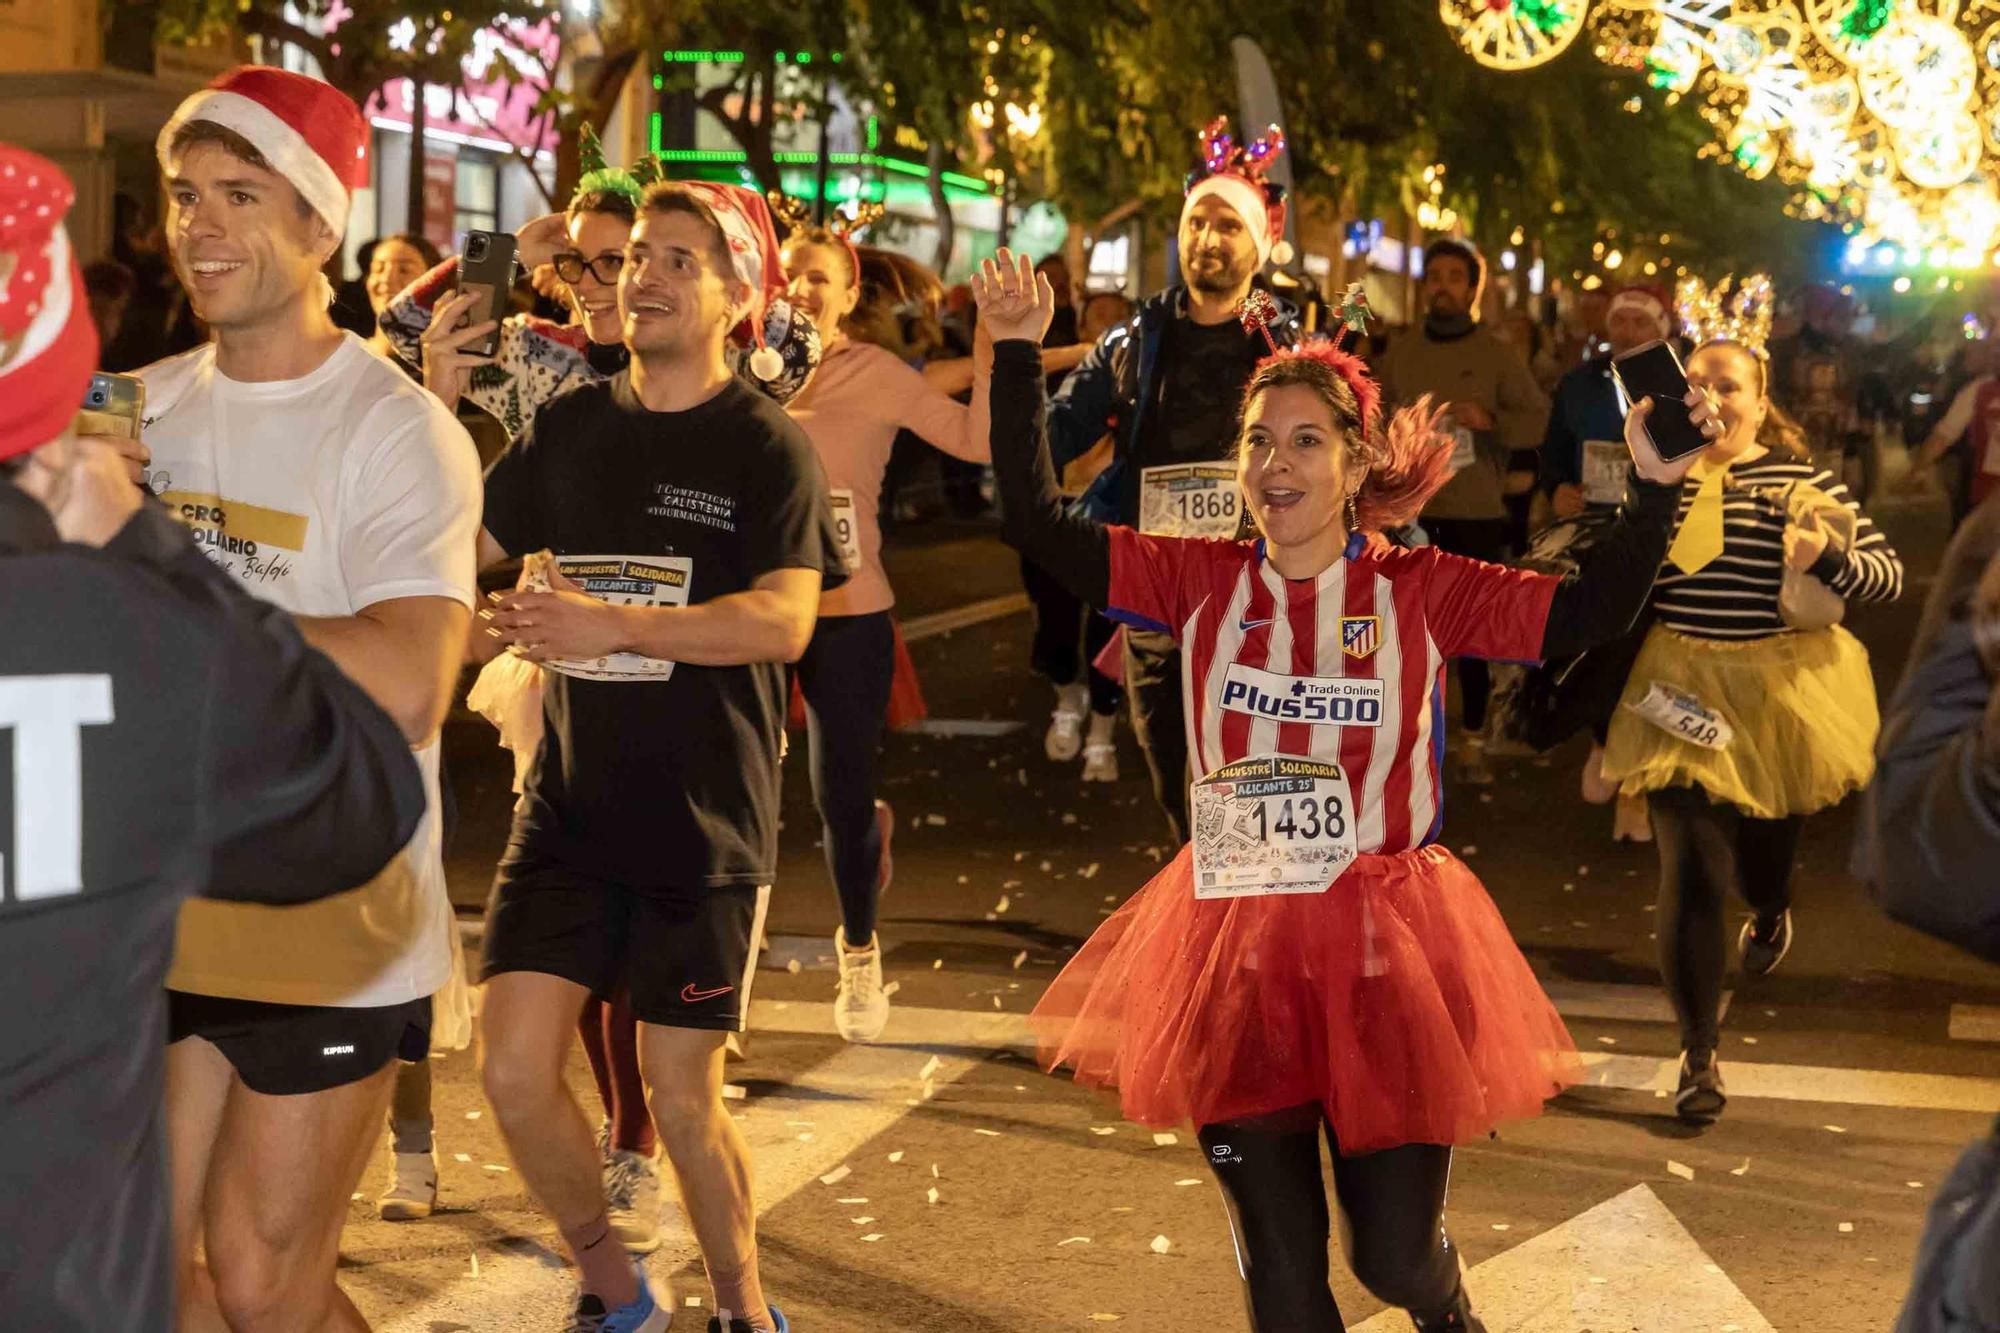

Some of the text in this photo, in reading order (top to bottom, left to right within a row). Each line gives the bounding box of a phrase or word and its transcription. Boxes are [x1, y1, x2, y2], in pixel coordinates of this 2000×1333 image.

[664, 495, 732, 518] CALISTENIA
[1178, 492, 1235, 520] 1868
[191, 527, 258, 556] OLIARIO
[629, 565, 684, 584] SOLIDARIA
[587, 580, 638, 592] ALICANTE
[1308, 684, 1380, 697] Trade Online
[1223, 680, 1379, 722] Plus500
[1220, 764, 1272, 779] SILVESTRE
[1279, 761, 1338, 778] SOLIDARIA
[1237, 780, 1295, 796] ALICANTE
[1252, 795, 1346, 842] 1438
[323, 1044, 354, 1056] KIPRUN
